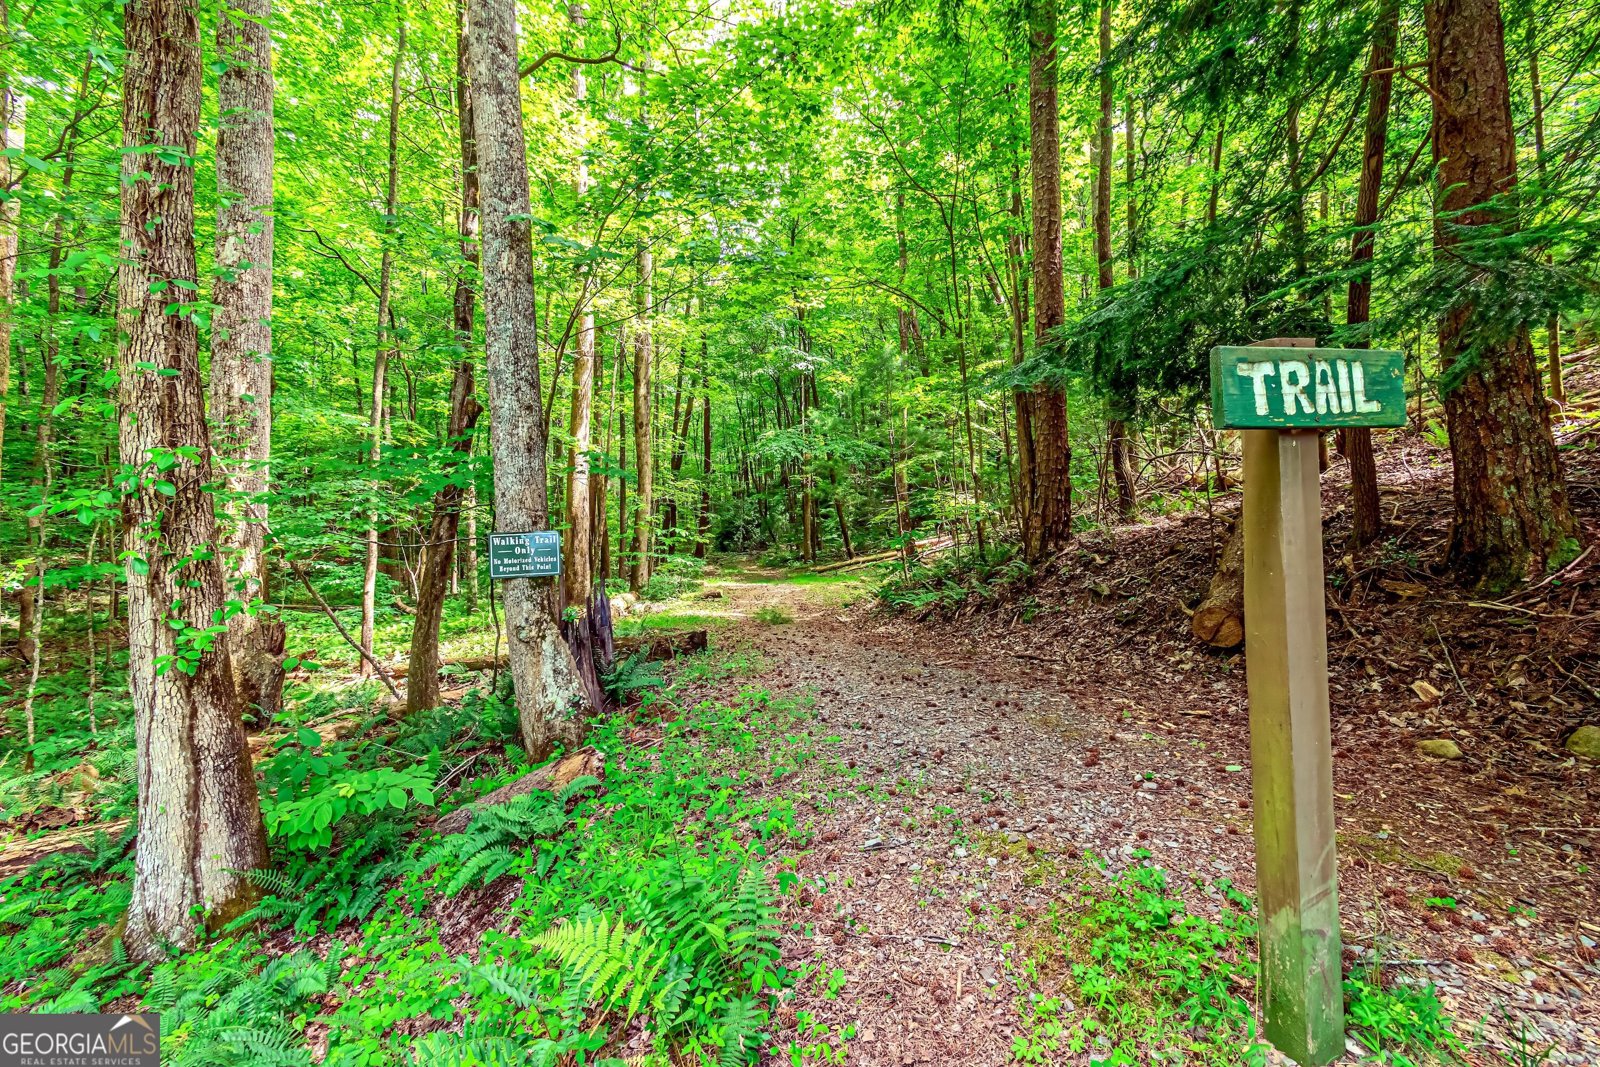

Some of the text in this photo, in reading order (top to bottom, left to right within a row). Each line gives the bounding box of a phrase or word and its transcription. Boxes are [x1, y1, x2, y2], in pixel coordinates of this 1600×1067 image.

[1237, 360, 1382, 416] TRAIL
[493, 535, 556, 546] Walking Trail
[514, 546, 535, 555] Only
